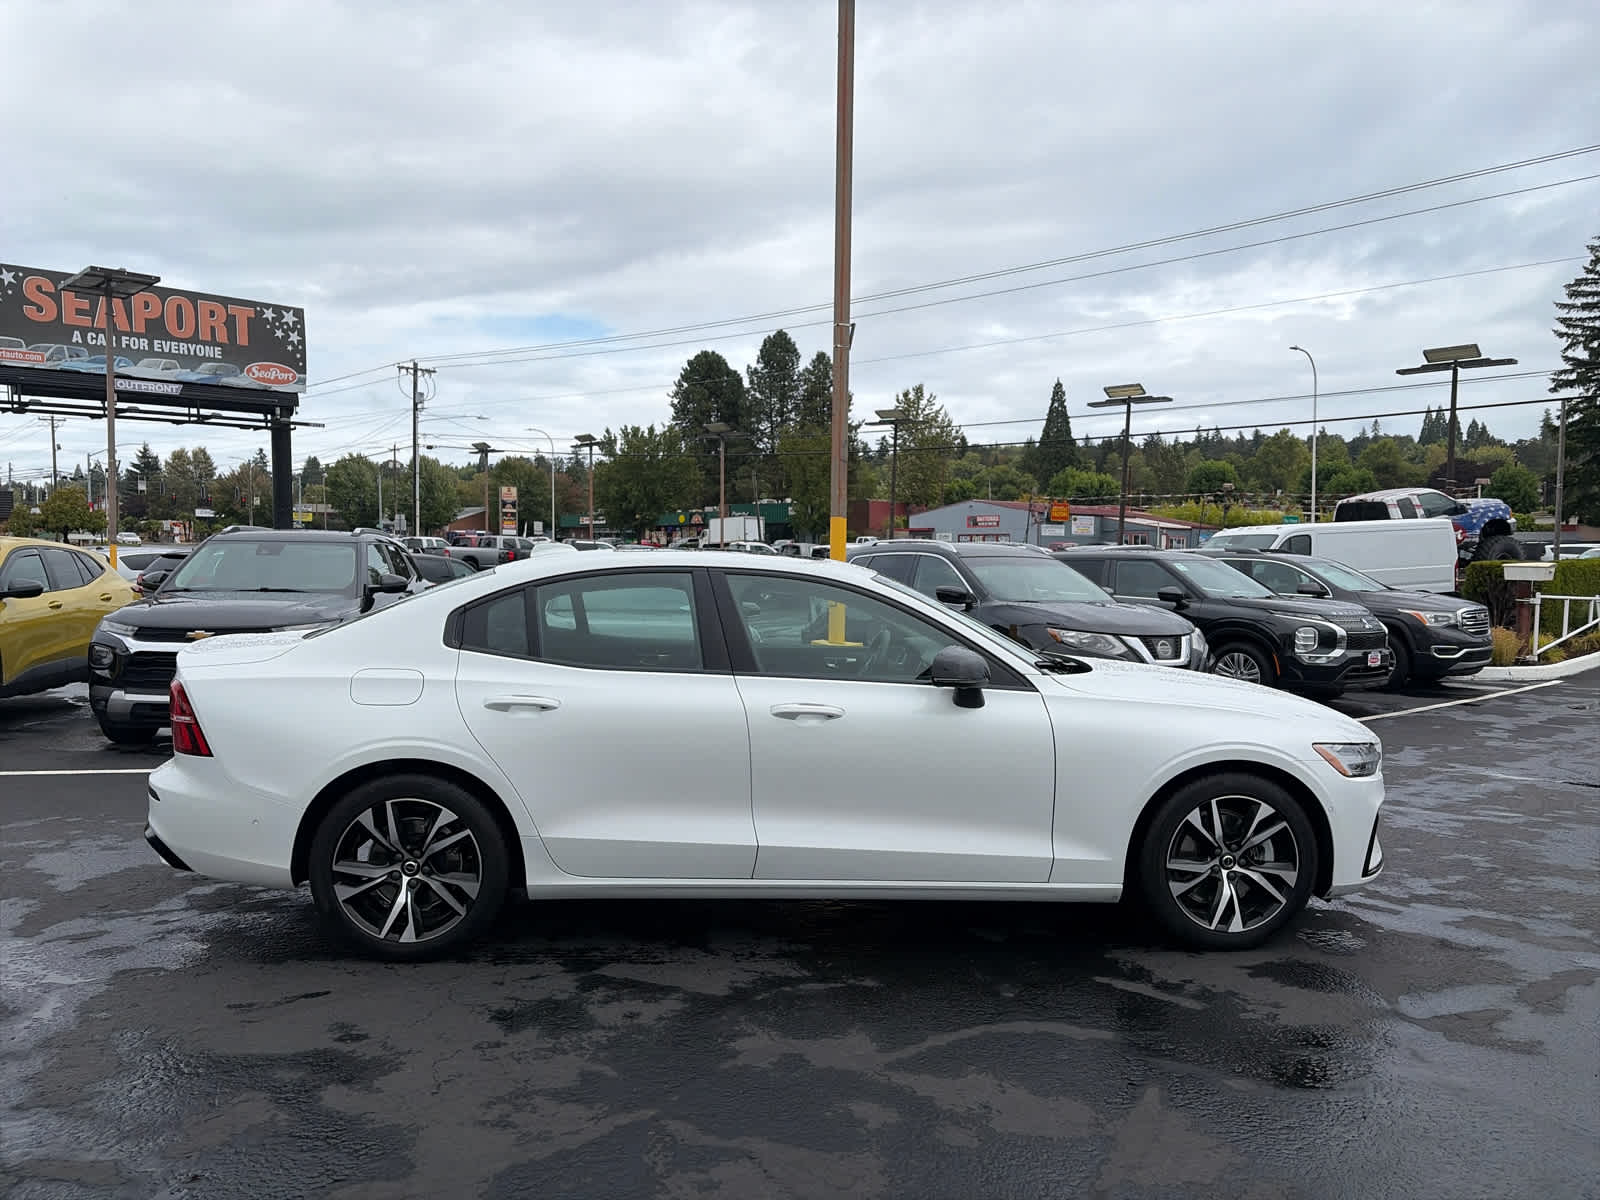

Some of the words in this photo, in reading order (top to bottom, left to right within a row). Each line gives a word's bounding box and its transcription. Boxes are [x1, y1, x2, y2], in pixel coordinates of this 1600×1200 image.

[22, 275, 256, 347] SEAPORT
[71, 330, 83, 344] A
[121, 336, 149, 351] FOR
[153, 339, 223, 359] EVERYONE
[249, 365, 294, 382] SeaPort
[116, 380, 179, 394] OUTFRONT
